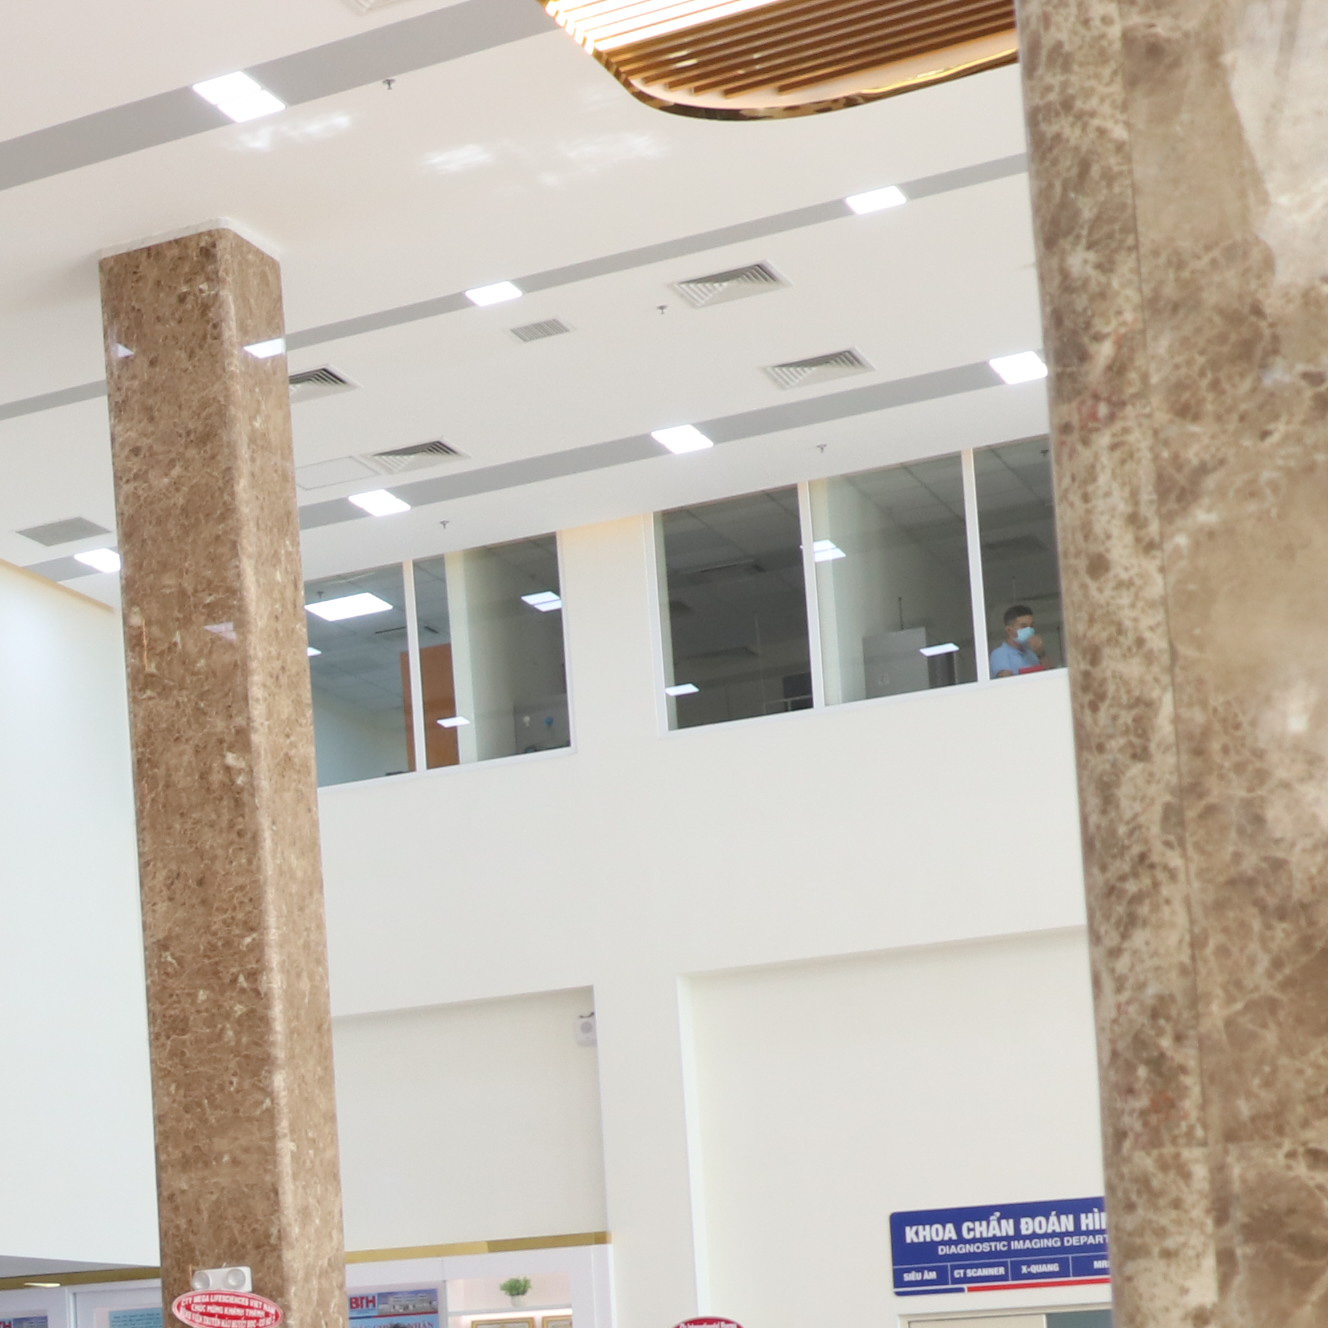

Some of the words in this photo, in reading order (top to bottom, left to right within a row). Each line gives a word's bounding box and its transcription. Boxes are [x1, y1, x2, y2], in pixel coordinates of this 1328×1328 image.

[905, 1223, 958, 1244] KHOA
[961, 1211, 1014, 1239] CHẨN
[1020, 1210, 1074, 1235] ĐOÁN
[937, 1241, 1009, 1256] DIAGNOSTIC
[1011, 1237, 1061, 1250] IMAGING
[903, 1270, 923, 1282] SIÊU
[923, 1269, 937, 1281] ÂM
[954, 1268, 965, 1279] CT
[966, 1266, 1005, 1278] SCANNER
[1020, 1262, 1060, 1275] X-QUANG
[349, 1295, 377, 1310] BTH
